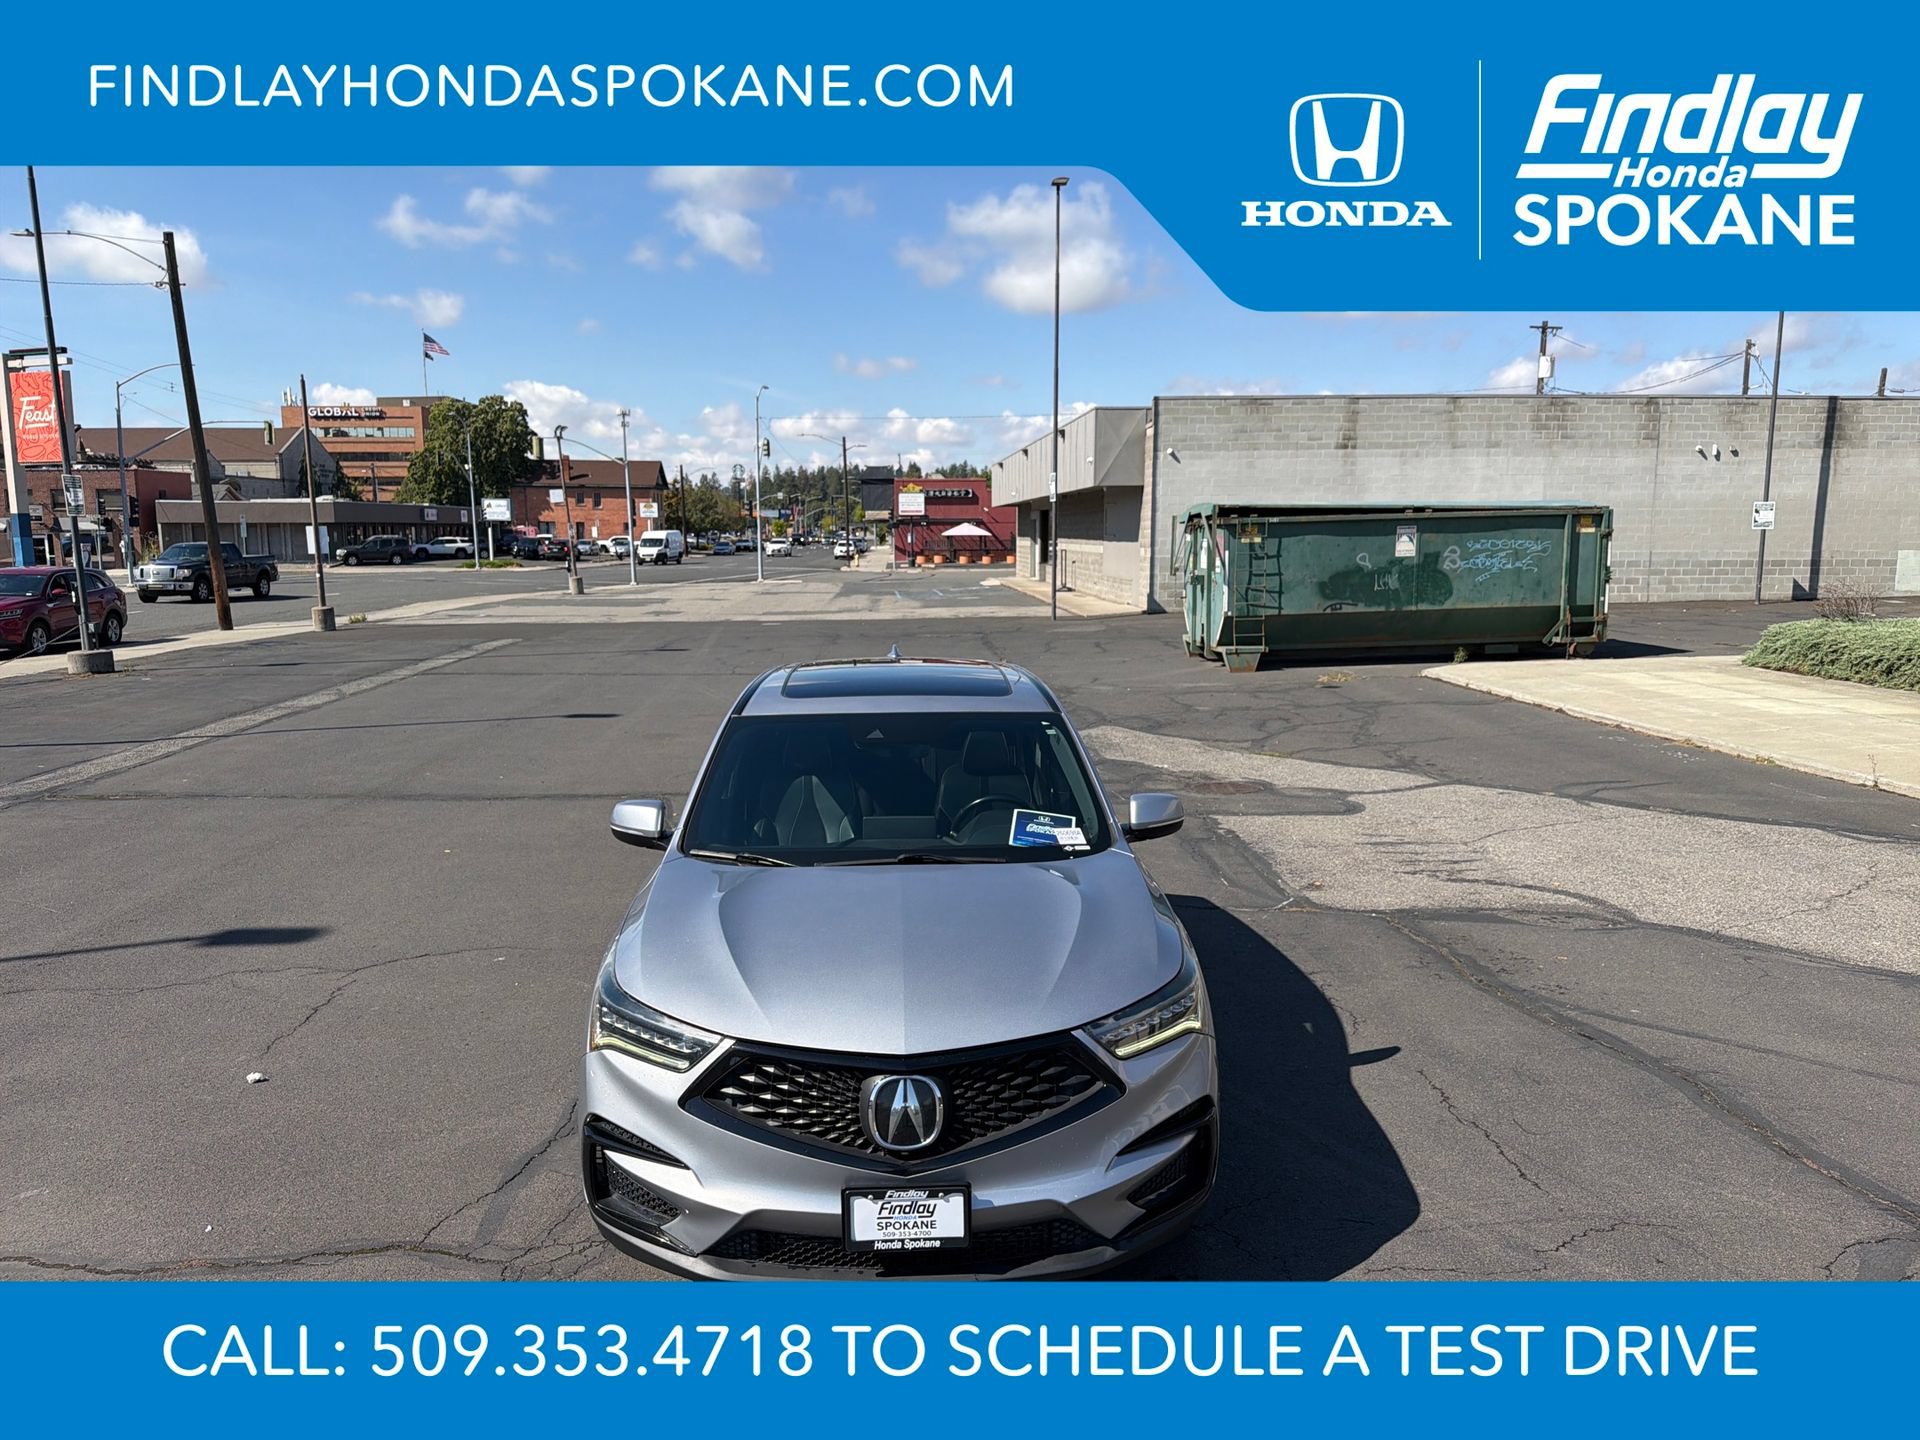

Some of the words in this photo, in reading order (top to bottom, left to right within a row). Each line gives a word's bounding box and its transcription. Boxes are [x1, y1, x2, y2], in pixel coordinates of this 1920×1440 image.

[19, 397, 56, 429] Feast
[307, 407, 359, 417] GLOBAL
[885, 1190, 929, 1199] Findlay
[877, 1201, 937, 1218] Findlay
[876, 1220, 937, 1231] SPOKANE
[874, 1240, 902, 1250] Honda
[904, 1239, 940, 1250] Spokane
